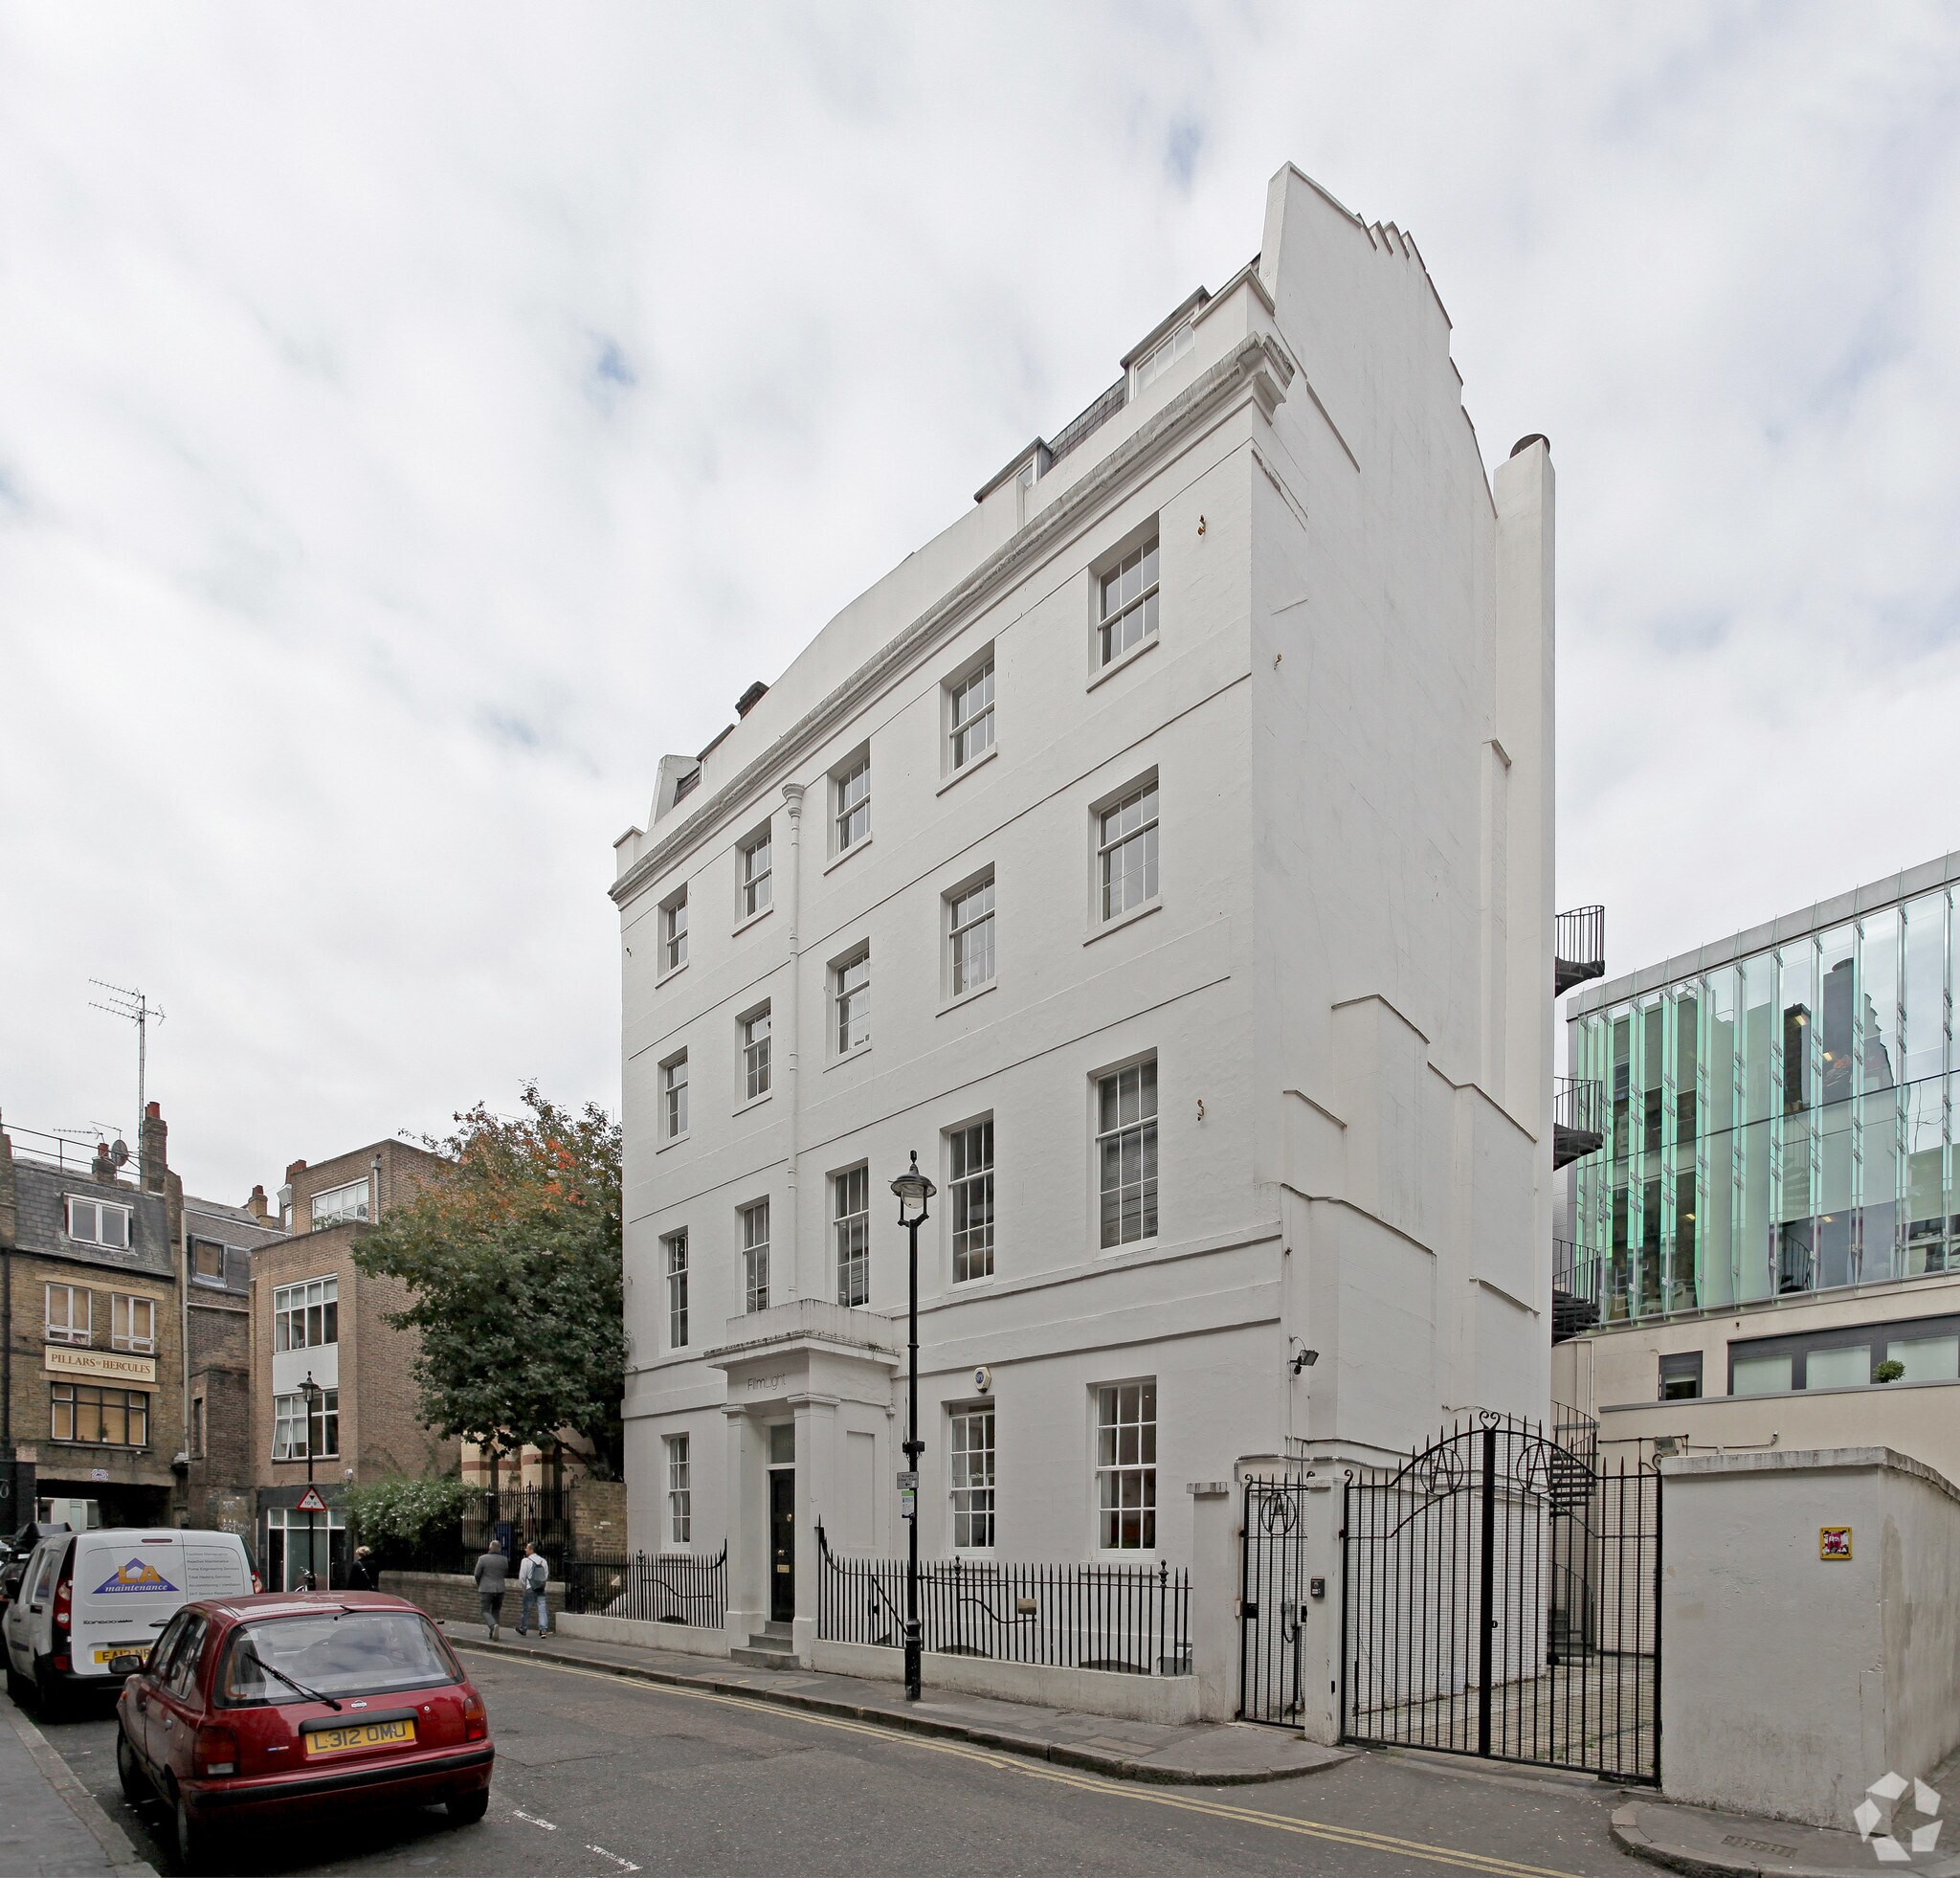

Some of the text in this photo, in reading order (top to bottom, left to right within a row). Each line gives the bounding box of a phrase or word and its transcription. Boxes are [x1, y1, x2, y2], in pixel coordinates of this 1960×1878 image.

[51, 1353, 96, 1367] PILLARS
[102, 1359, 151, 1374] HERCULES
[118, 1565, 162, 1584] LA
[104, 1584, 168, 1593] maintenance
[314, 1722, 406, 1750] L312 OMU
